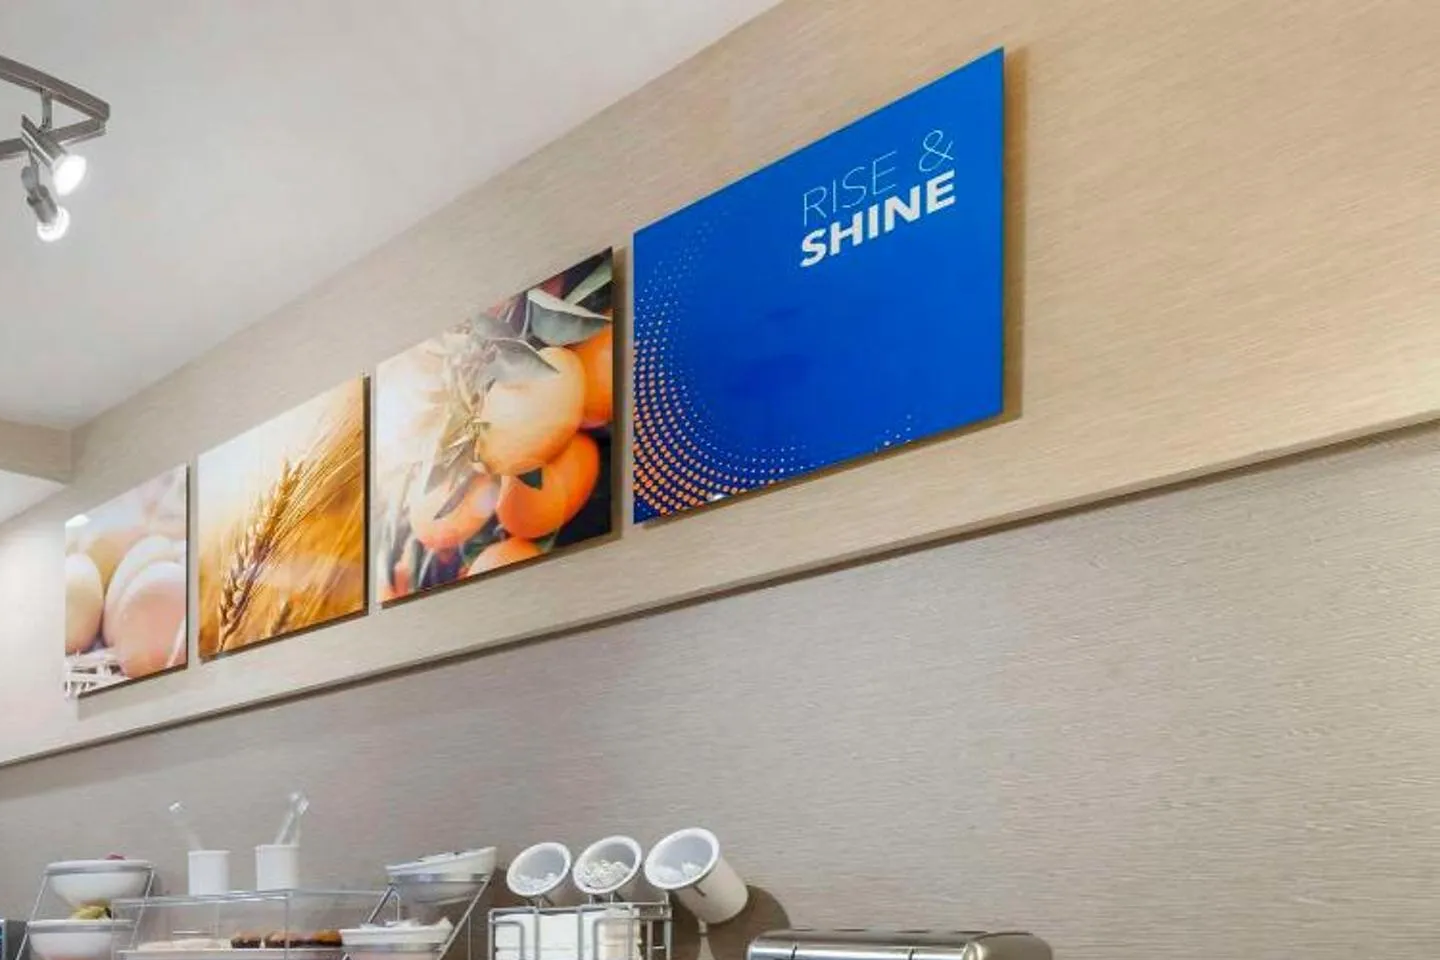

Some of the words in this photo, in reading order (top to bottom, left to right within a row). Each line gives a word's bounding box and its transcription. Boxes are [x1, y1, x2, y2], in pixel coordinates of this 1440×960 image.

[799, 168, 956, 267] SHINE
[803, 150, 897, 228] RISE
[918, 129, 955, 172] &
